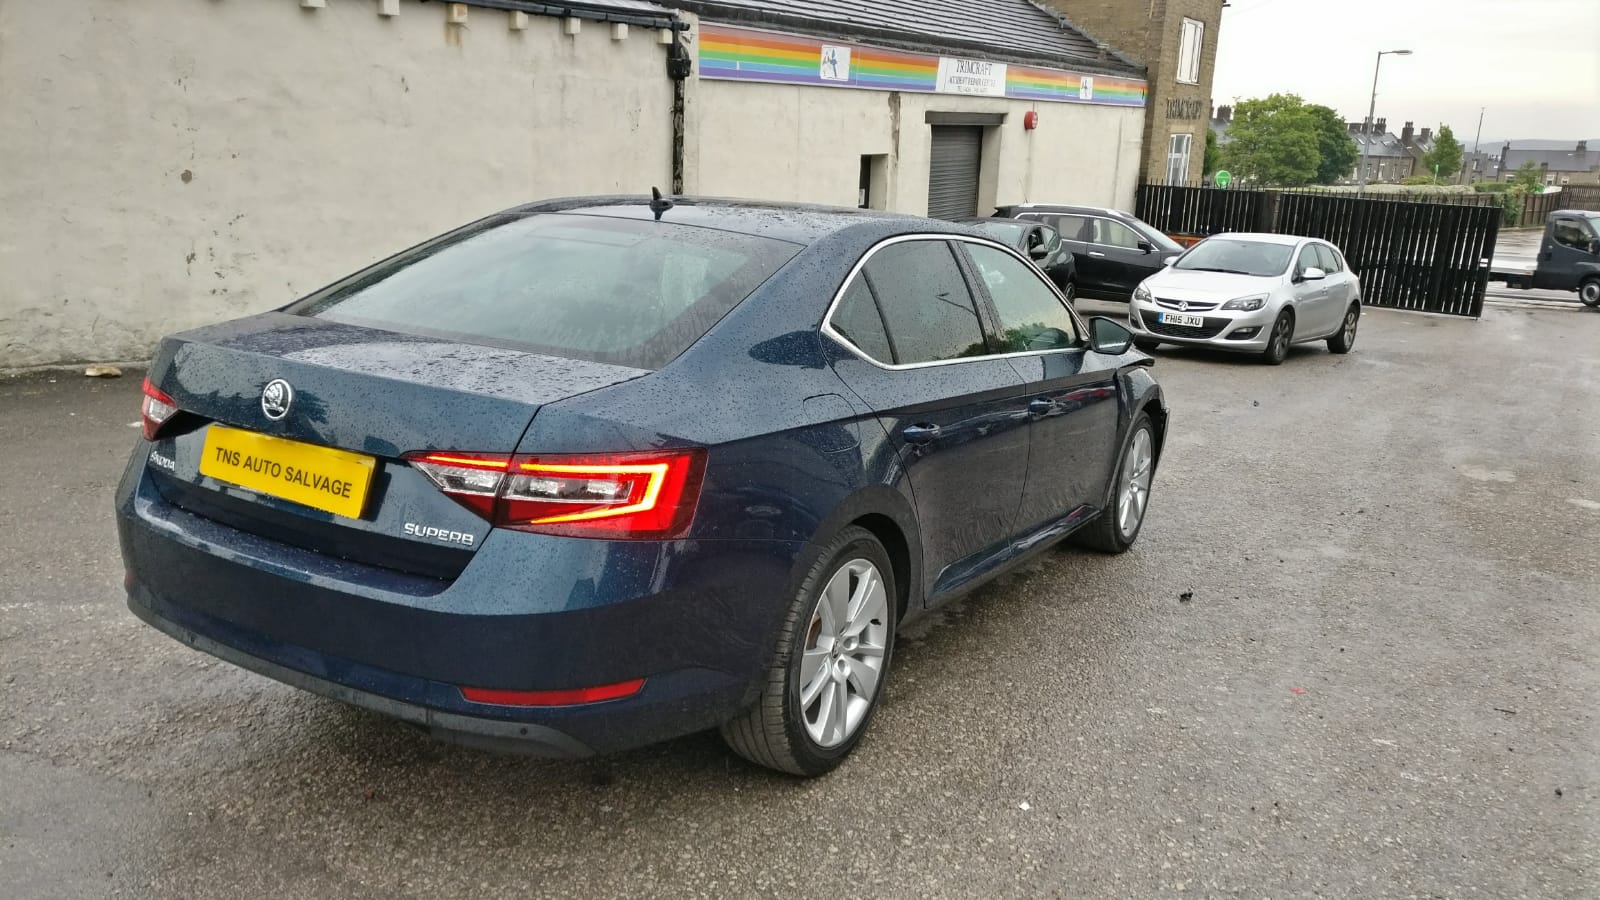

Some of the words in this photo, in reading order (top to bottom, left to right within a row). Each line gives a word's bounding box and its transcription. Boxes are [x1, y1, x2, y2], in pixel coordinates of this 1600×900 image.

[956, 60, 992, 75] TRIMCRAFT
[1165, 314, 1183, 323] FH15
[1184, 316, 1201, 326] JXU
[215, 447, 240, 466] TNS
[243, 455, 281, 478] AUTO
[284, 466, 352, 498] SALVAGE
[404, 522, 474, 545] SUPERB
